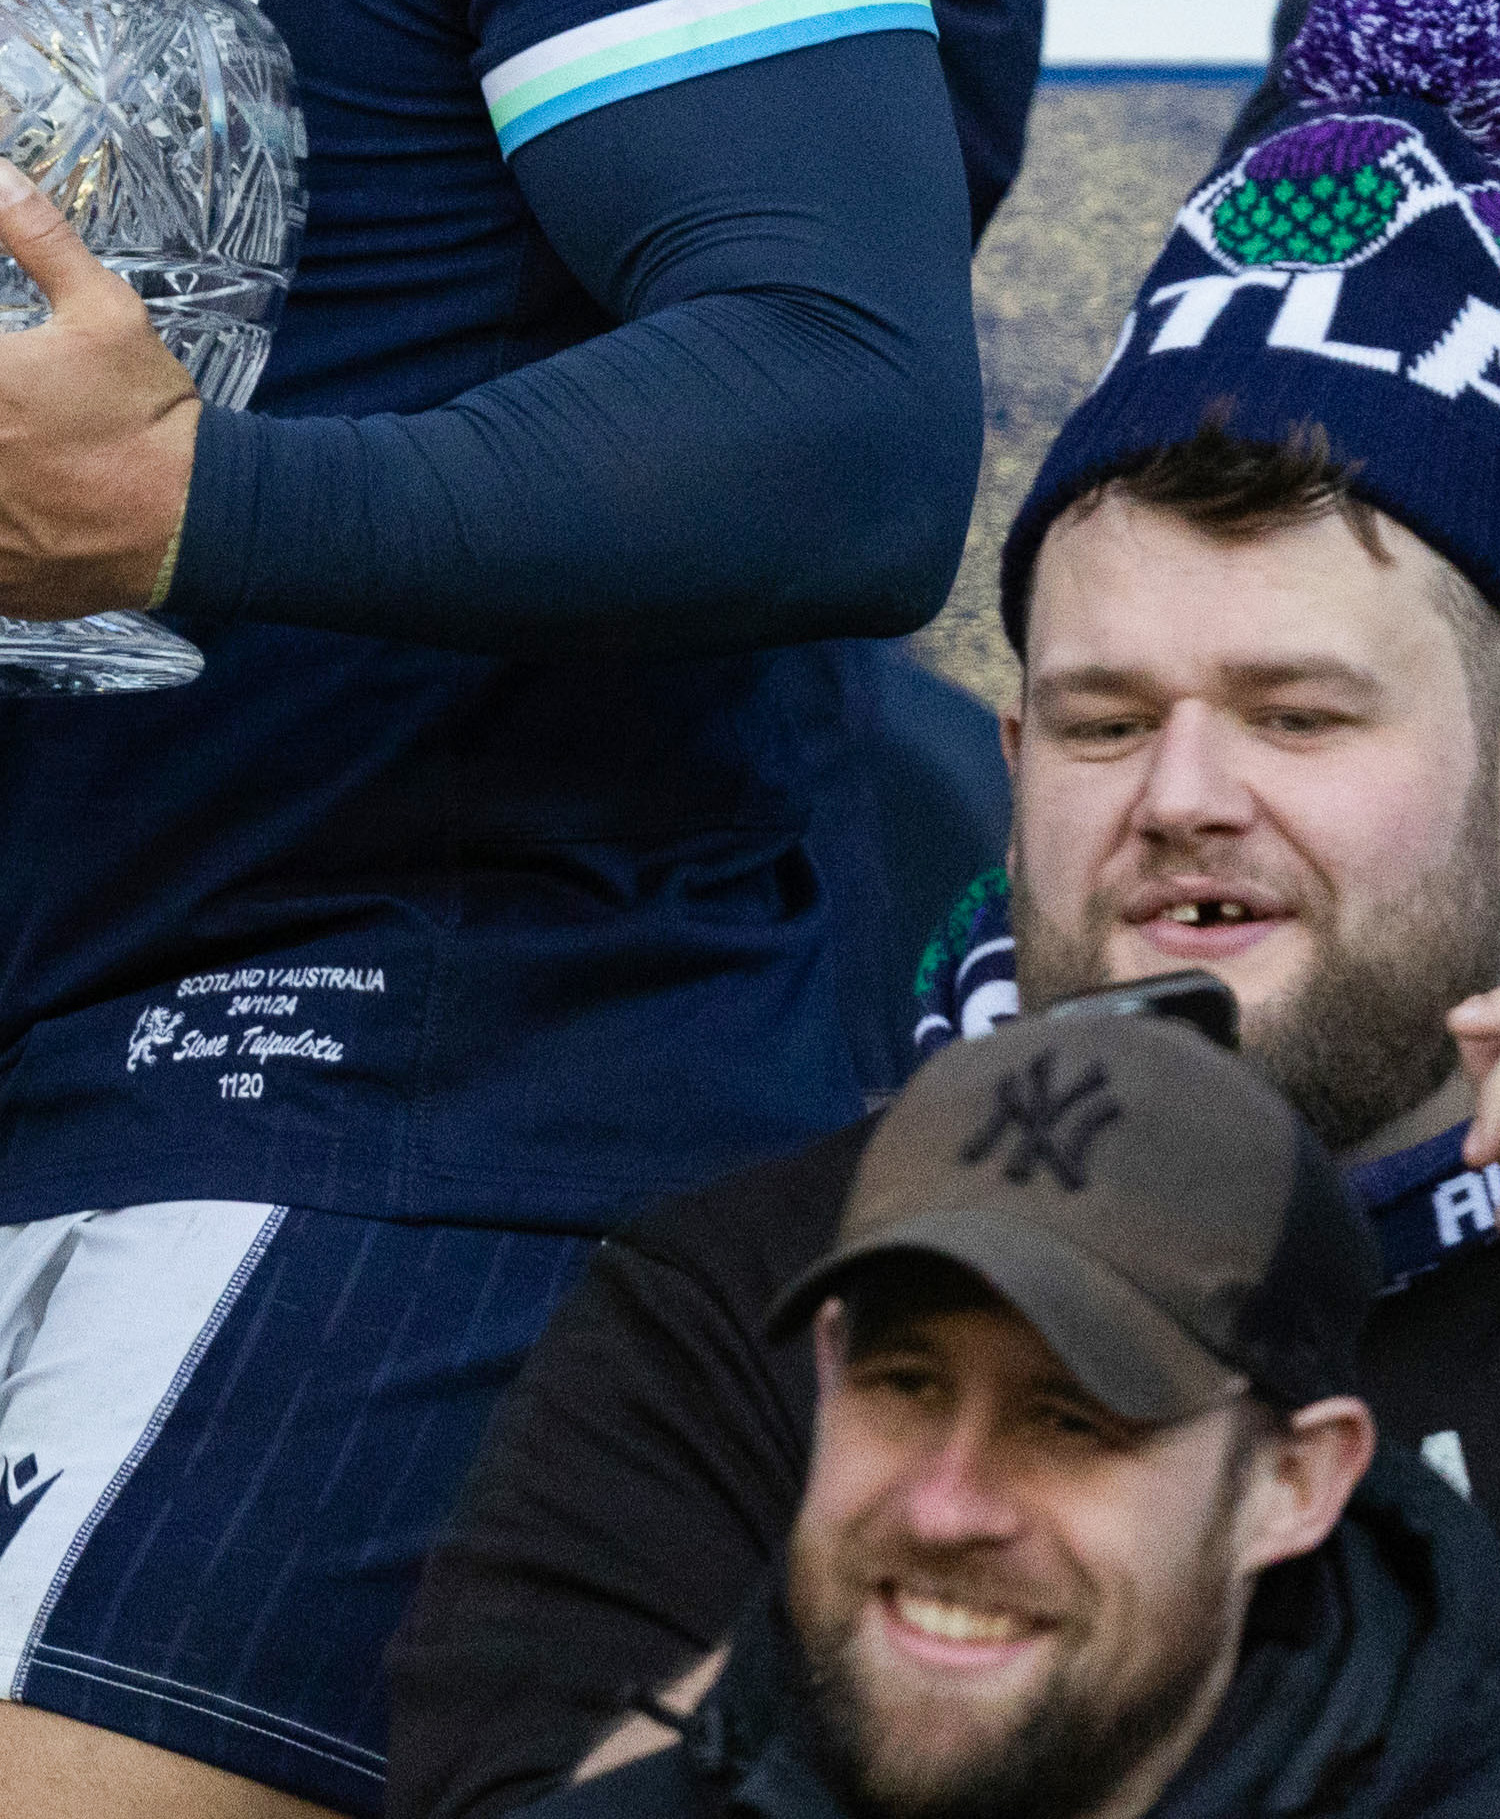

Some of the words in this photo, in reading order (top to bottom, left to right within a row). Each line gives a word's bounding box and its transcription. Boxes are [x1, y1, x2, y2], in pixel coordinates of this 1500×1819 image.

[177, 968, 265, 997] SCOTLAND
[279, 967, 385, 993] AUSTRALIA
[227, 995, 298, 1016] 24/11/24
[219, 1072, 264, 1099] 1120
[959, 1046, 1122, 1193] NY
